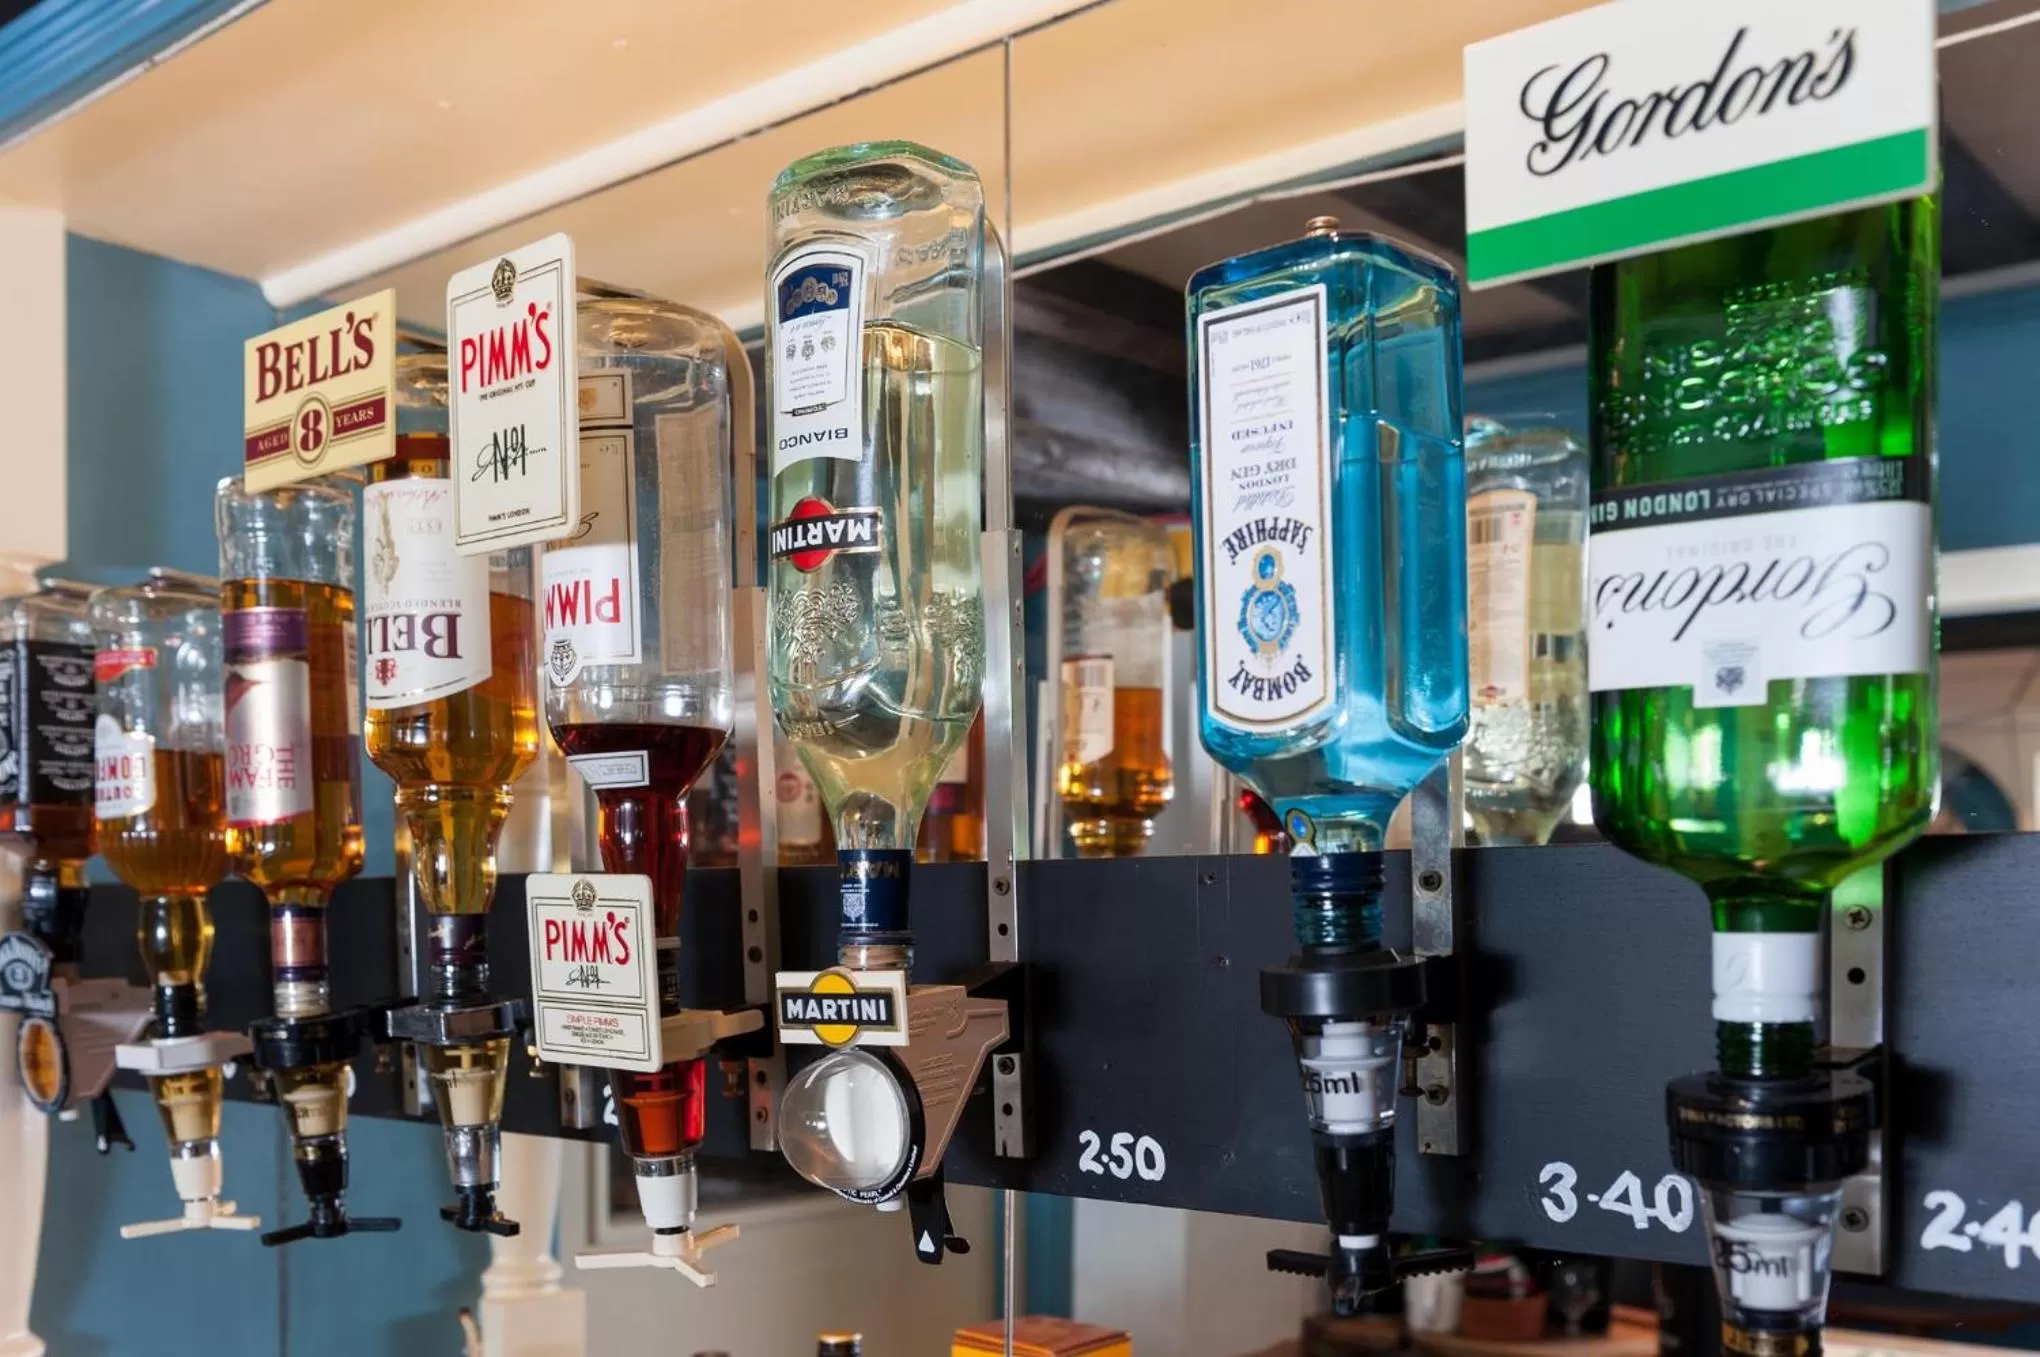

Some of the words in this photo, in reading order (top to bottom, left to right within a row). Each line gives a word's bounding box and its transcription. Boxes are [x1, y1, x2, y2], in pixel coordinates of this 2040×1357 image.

[1520, 26, 1858, 177] Gordon's
[255, 311, 374, 404] BELL'S
[461, 302, 551, 394] PIMM'S
[256, 432, 288, 451] AGED
[300, 409, 323, 452] 8
[335, 406, 374, 429] YEARS
[779, 427, 849, 451] BIANCO
[1232, 419, 1294, 441] INFUSED
[1230, 464, 1261, 481] GIN
[1238, 474, 1289, 490] LONDON
[1263, 457, 1297, 475] DRY
[1624, 489, 1710, 519] LONDON
[772, 518, 871, 555] MARTINI
[1222, 517, 1313, 560] SAPPHIRE
[406, 598, 463, 610] BLENDED
[1594, 541, 1896, 643] Gordon's
[1227, 656, 1312, 702] BOMBAY
[277, 744, 296, 789] THE
[545, 911, 630, 965] PIMM'S
[786, 997, 886, 1021] MARTINI
